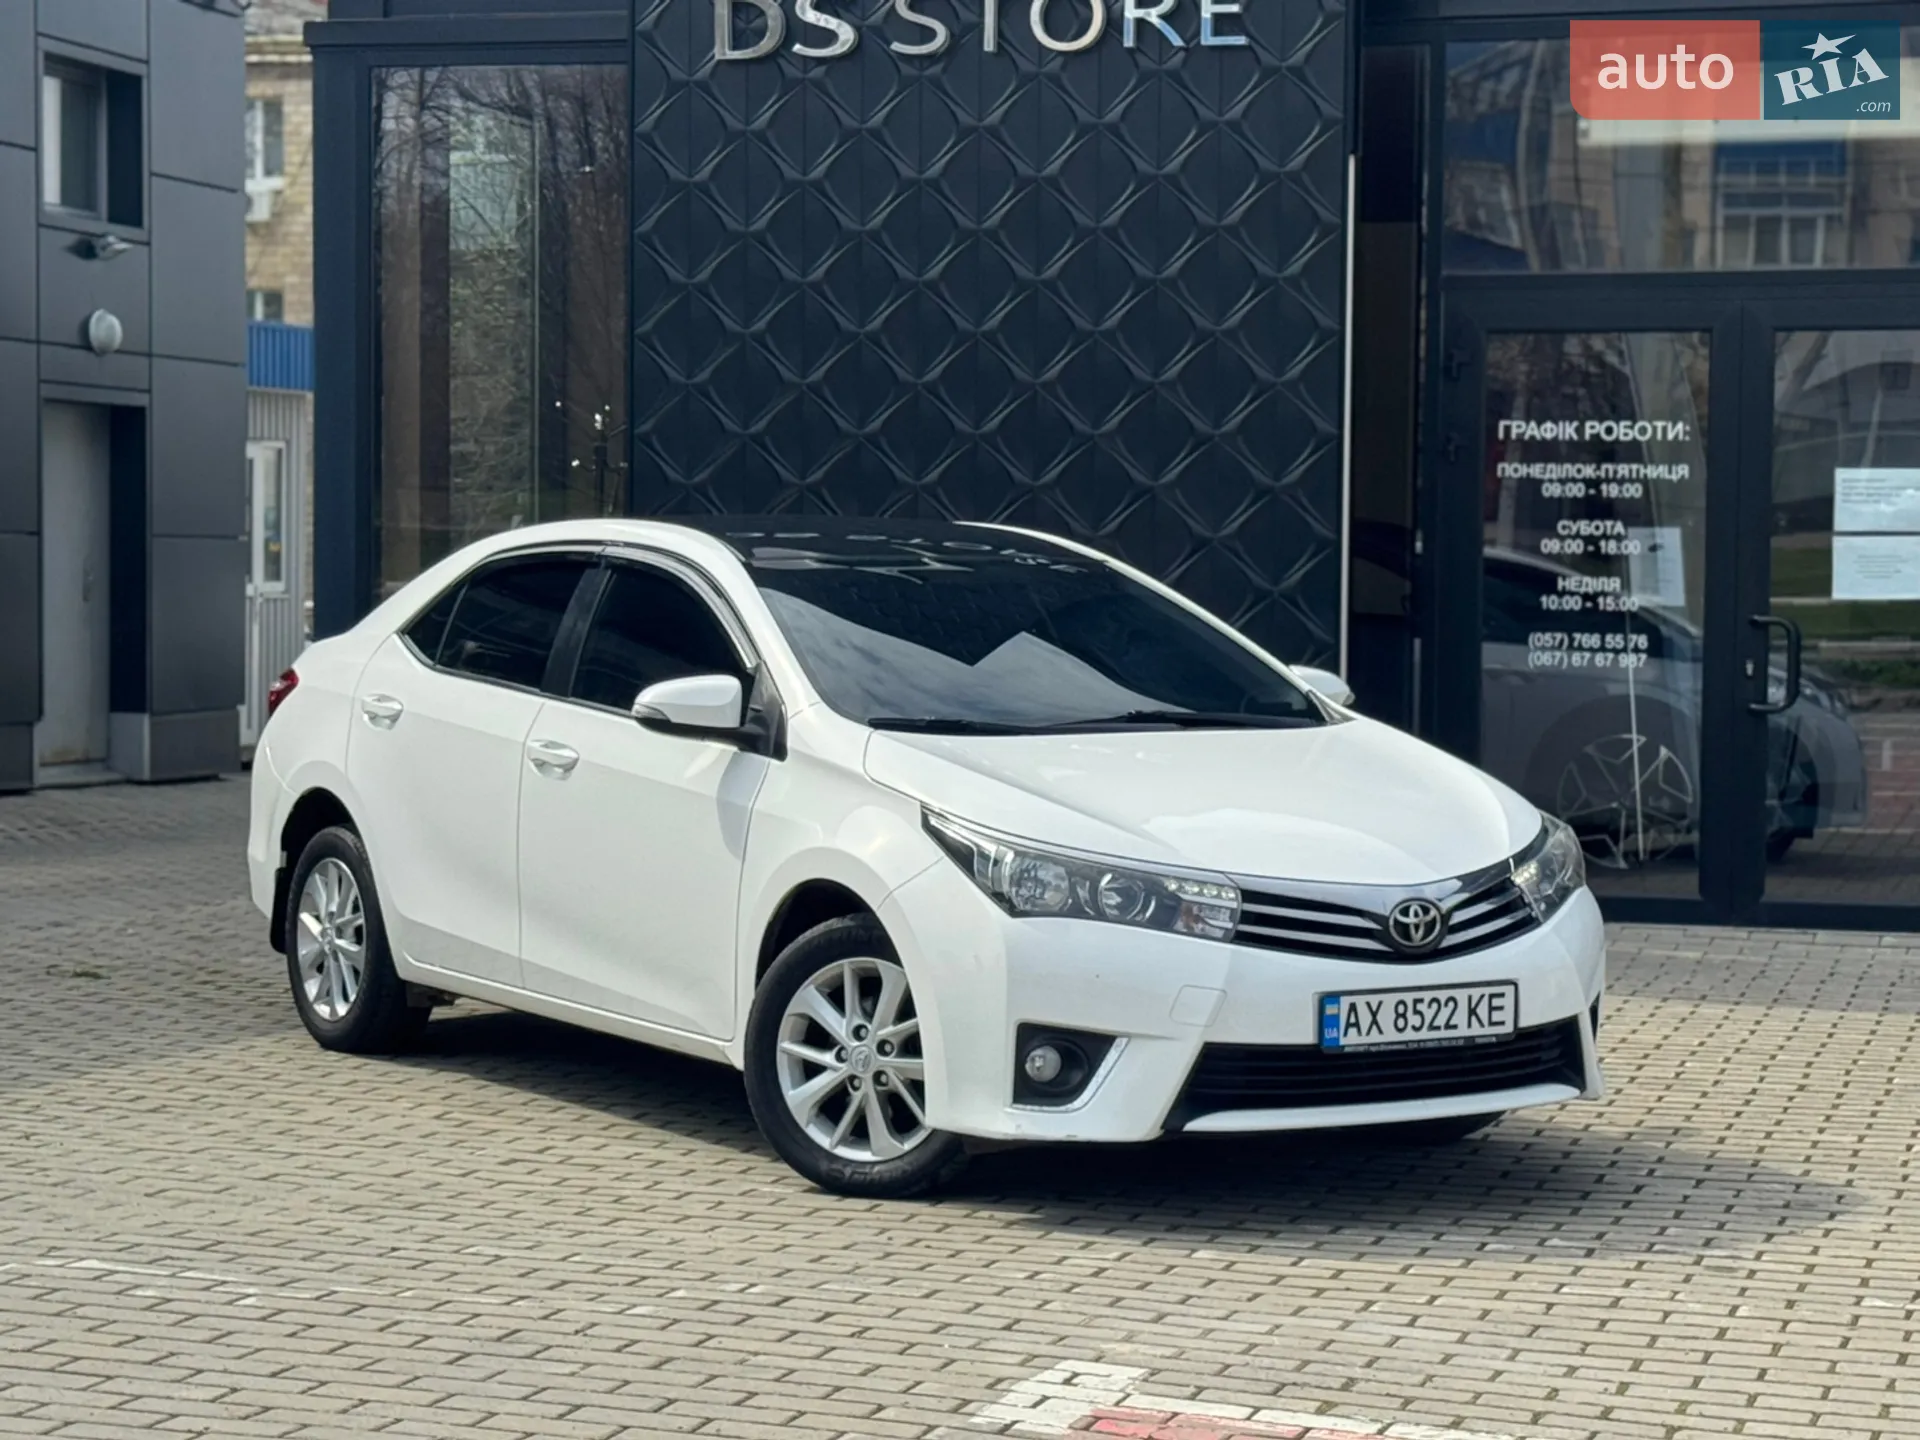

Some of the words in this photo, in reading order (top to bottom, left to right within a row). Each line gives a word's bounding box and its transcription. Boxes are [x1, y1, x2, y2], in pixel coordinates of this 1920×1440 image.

[714, 0, 858, 59] DS
[1497, 420, 1579, 441] ГРАФІК
[1584, 420, 1691, 441] РОБОТИ:
[1541, 482, 1585, 498] 09:00
[1600, 483, 1643, 498] 19:00
[1557, 520, 1625, 536] СУБОТА
[1540, 539, 1584, 554] 09:00
[1557, 577, 1621, 594] НЕДІЛЯ
[1540, 595, 1582, 611] 10:00
[1528, 632, 1569, 650] (057)
[1343, 1000, 1384, 1037] AX
[1393, 996, 1459, 1033] 8522
[1467, 992, 1506, 1029] KE
[1325, 1027, 1338, 1039] UA
